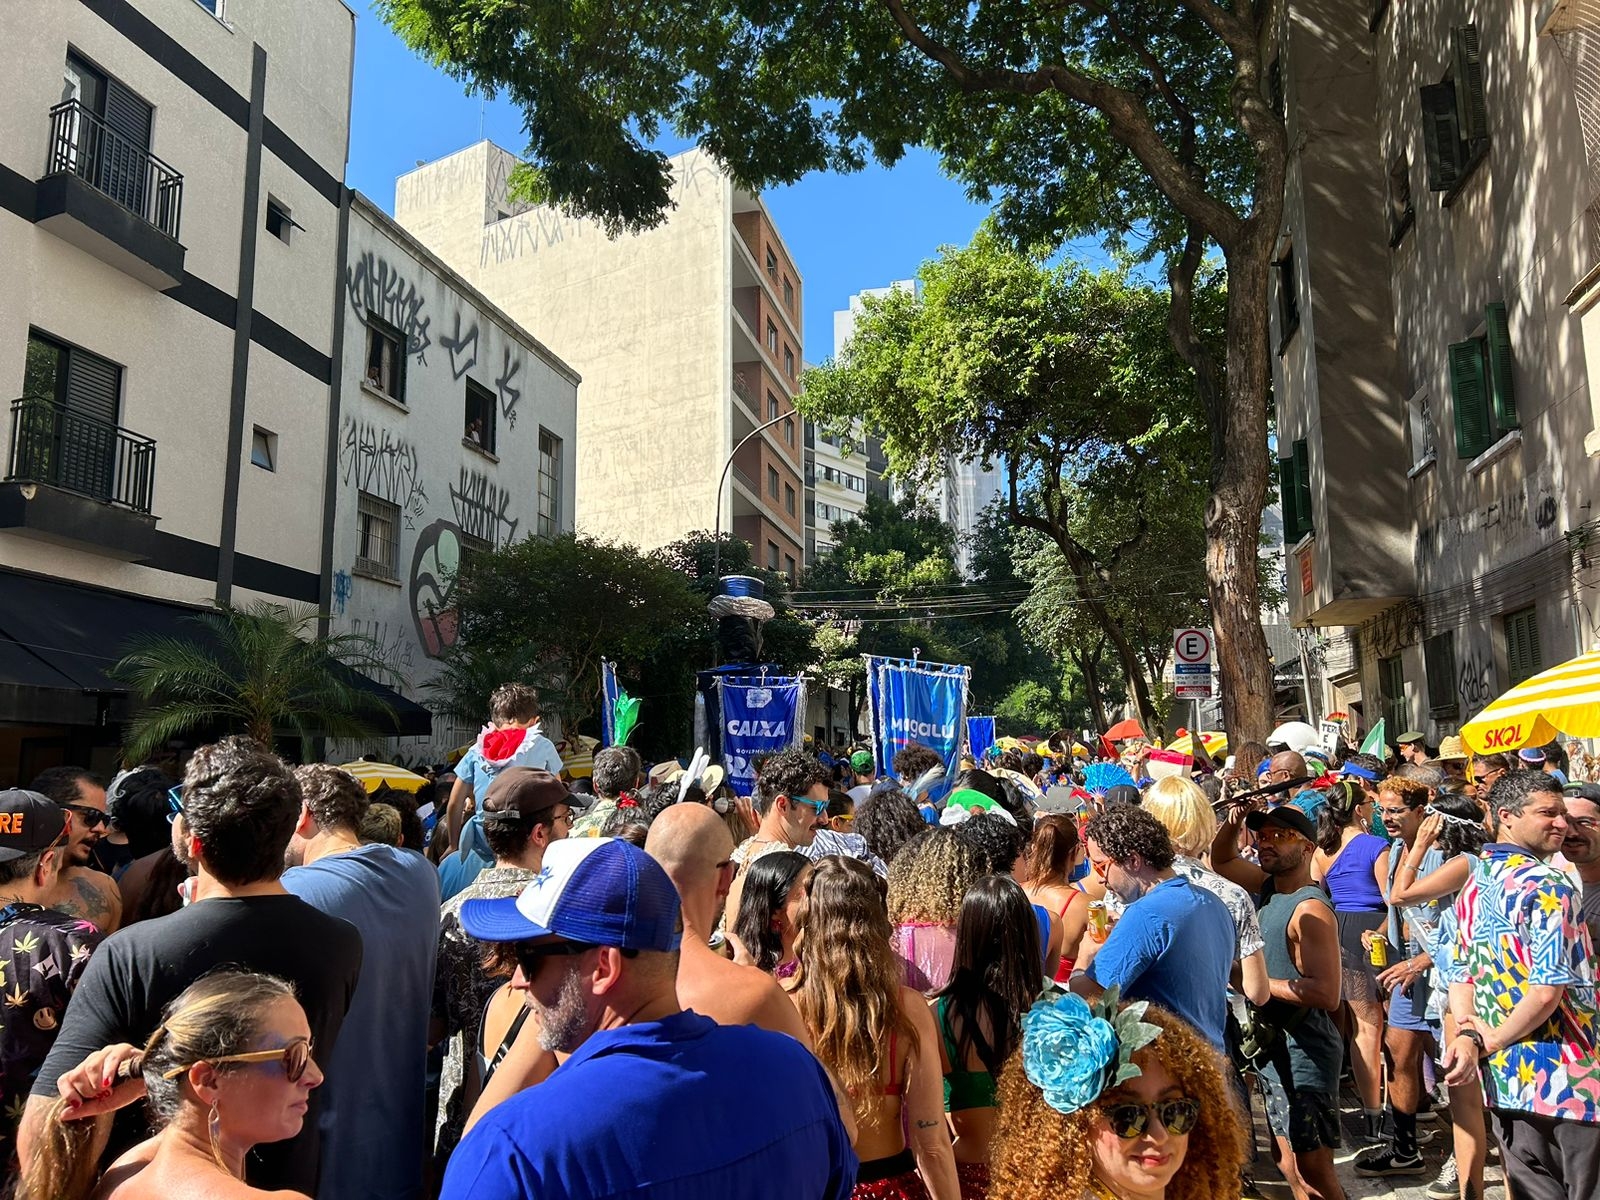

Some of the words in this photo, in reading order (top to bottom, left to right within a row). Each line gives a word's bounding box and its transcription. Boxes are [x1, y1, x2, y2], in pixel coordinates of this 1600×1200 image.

[1186, 638, 1198, 655] E
[727, 720, 786, 737] CAIXA
[1484, 724, 1521, 749] SKOL
[0, 812, 24, 834] RE
